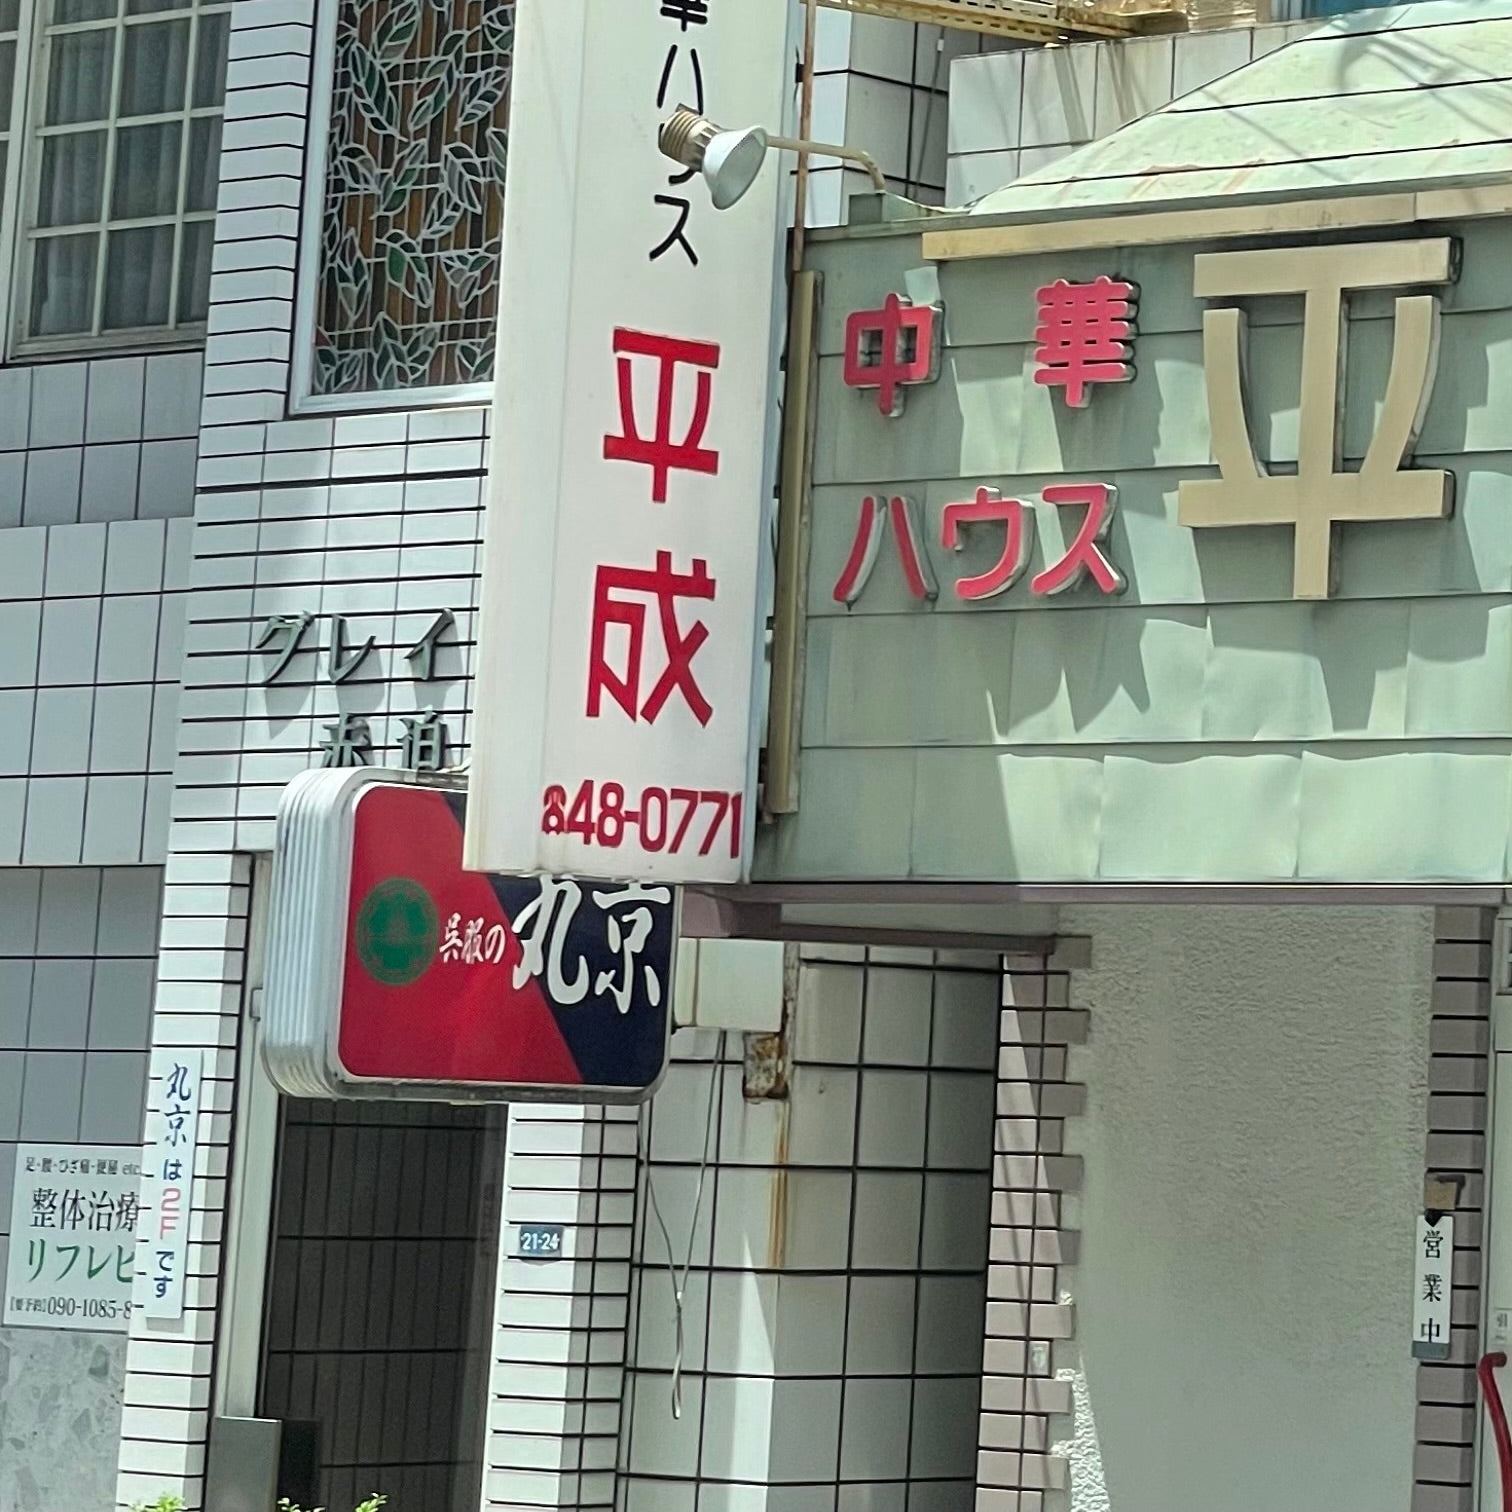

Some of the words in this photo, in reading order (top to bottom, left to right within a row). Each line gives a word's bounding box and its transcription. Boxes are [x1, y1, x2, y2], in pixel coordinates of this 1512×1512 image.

[843, 274, 1138, 417] 中華
[585, 324, 720, 728] 平成
[833, 483, 1128, 603] ハウス
[29, 1187, 140, 1232] 整体治療
[1420, 1230, 1444, 1344] 営業中
